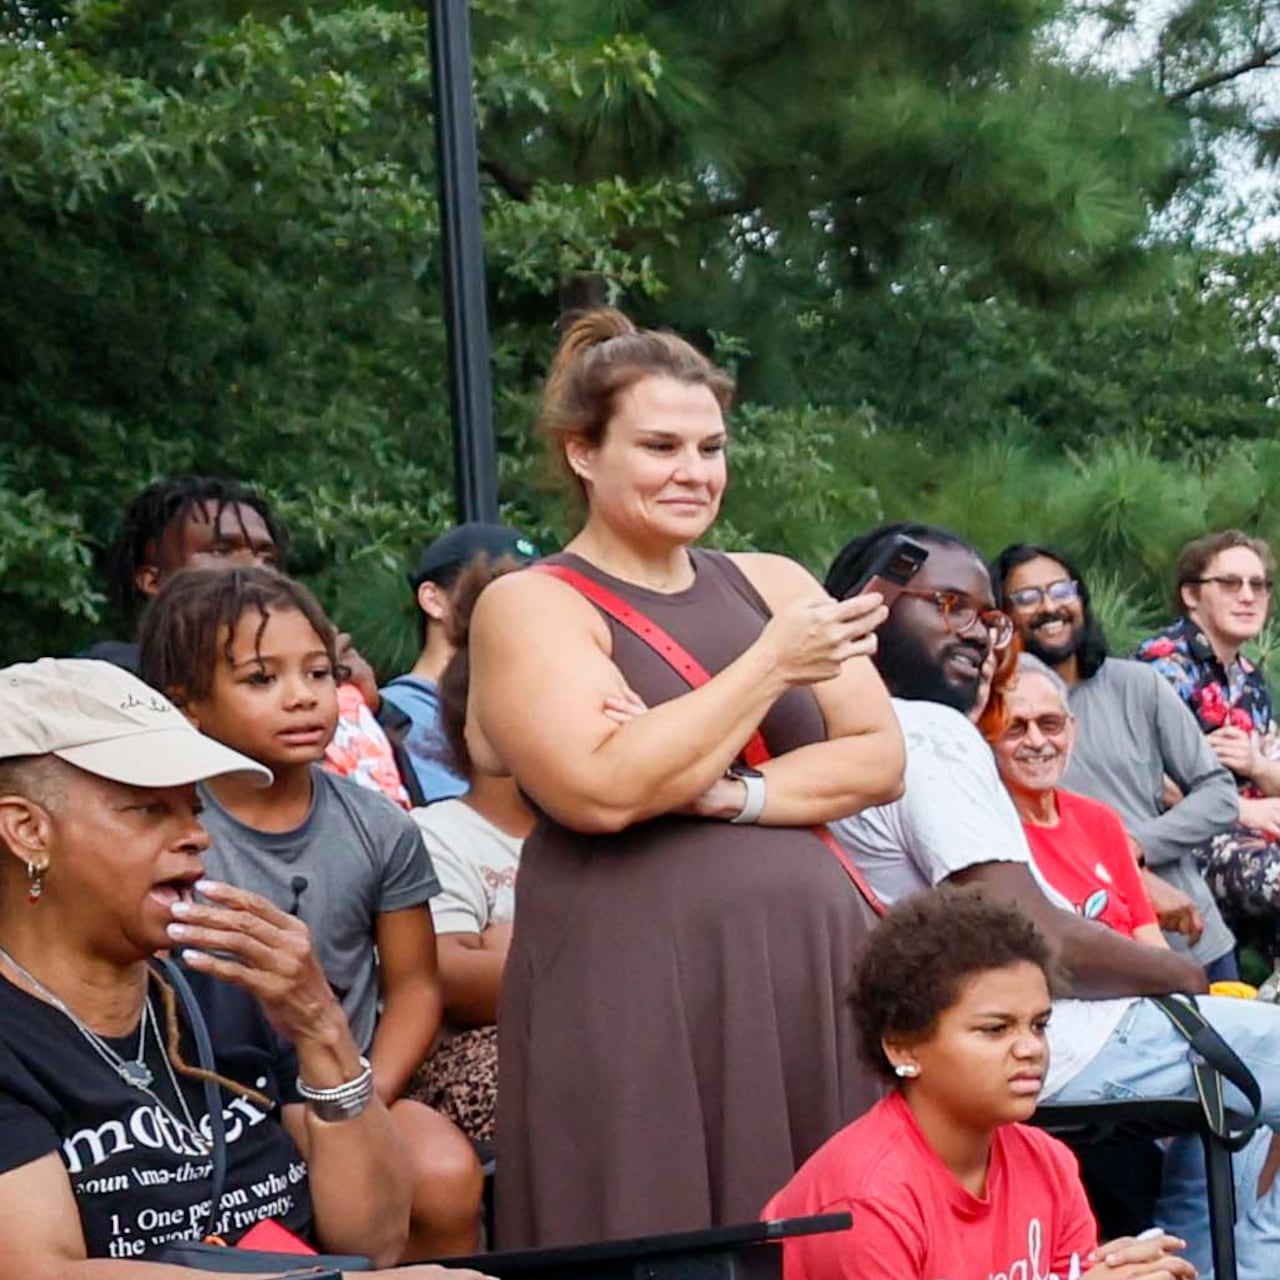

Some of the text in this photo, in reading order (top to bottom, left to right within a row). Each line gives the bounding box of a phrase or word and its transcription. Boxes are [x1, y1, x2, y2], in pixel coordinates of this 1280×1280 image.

[110, 1214, 131, 1236] 1.
[137, 1208, 185, 1231] One
[188, 1188, 249, 1227] peon
[250, 1172, 289, 1199] who
[108, 1236, 147, 1258] the
